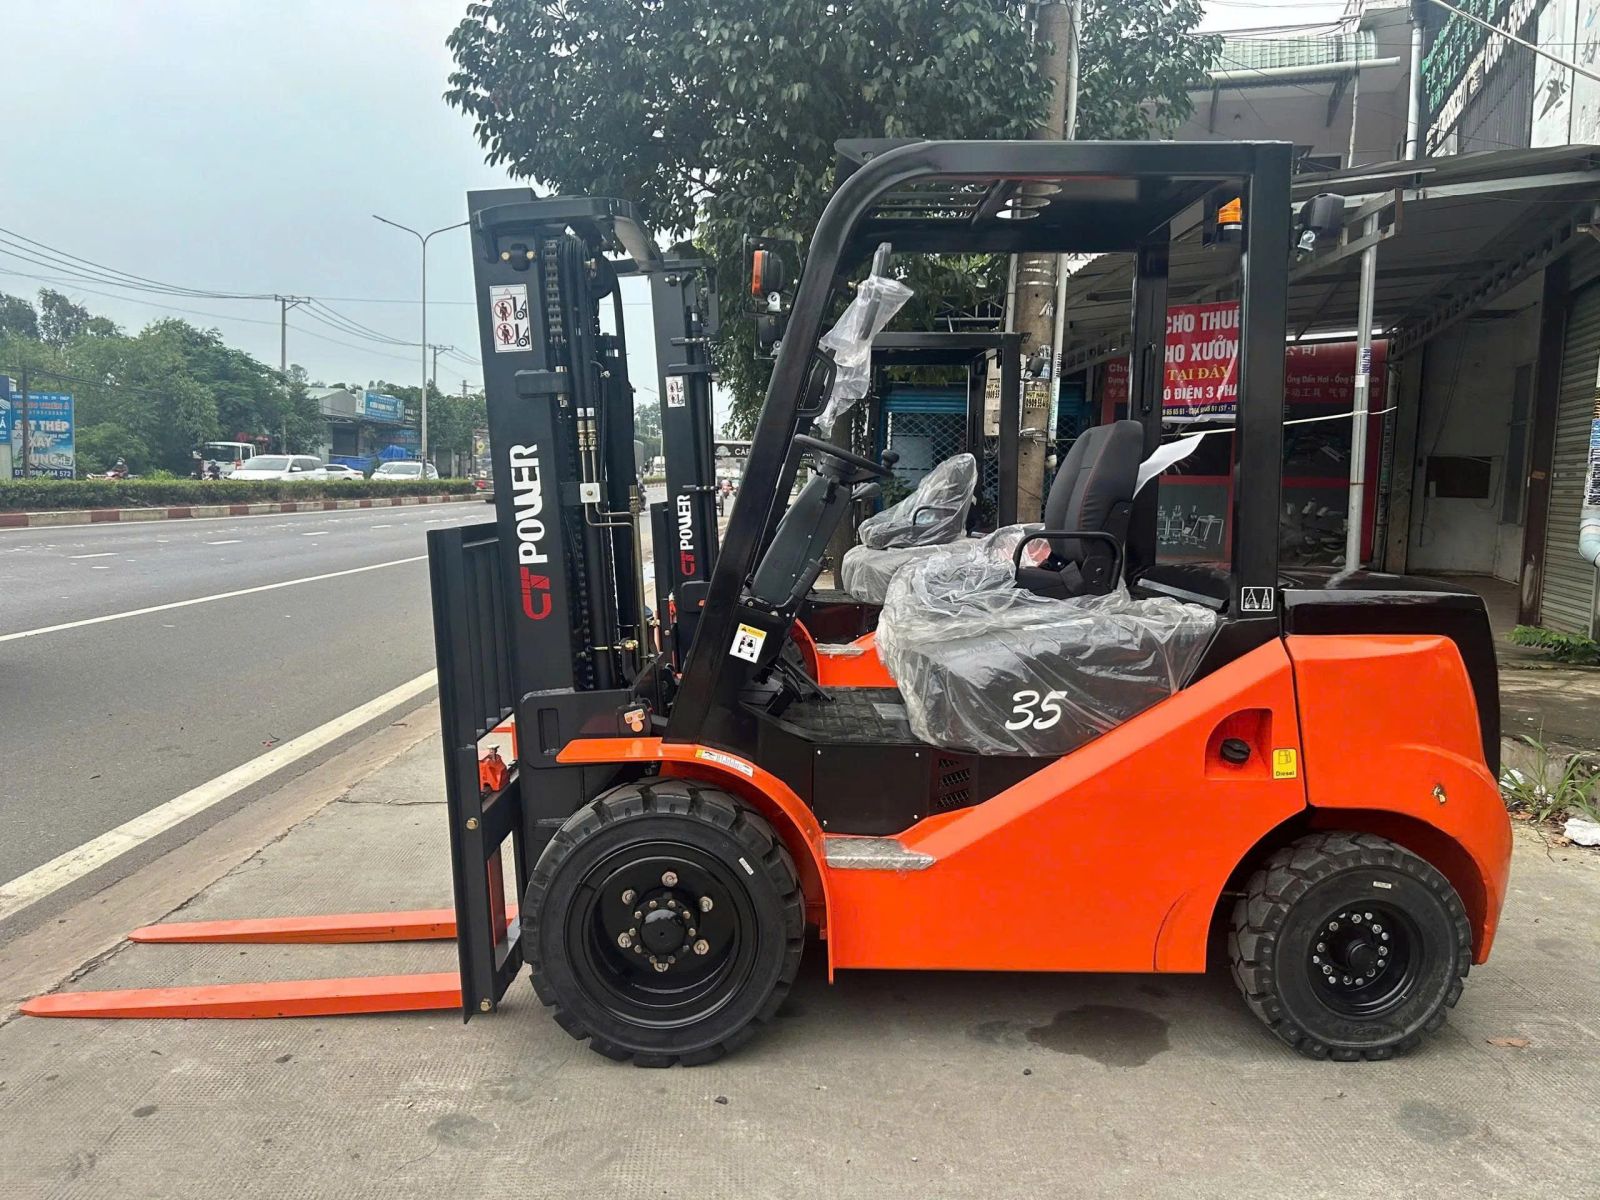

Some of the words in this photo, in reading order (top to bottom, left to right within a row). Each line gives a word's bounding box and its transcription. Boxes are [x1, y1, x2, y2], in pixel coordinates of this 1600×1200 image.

[1164, 344, 1185, 363] HO
[1191, 335, 1239, 361] XƯỞN
[1108, 364, 1129, 372] Chu
[1163, 386, 1171, 400] Ó
[1205, 386, 1213, 398] 3
[509, 444, 549, 565] POWER
[676, 494, 694, 550] POWER
[1005, 690, 1068, 731] 35
